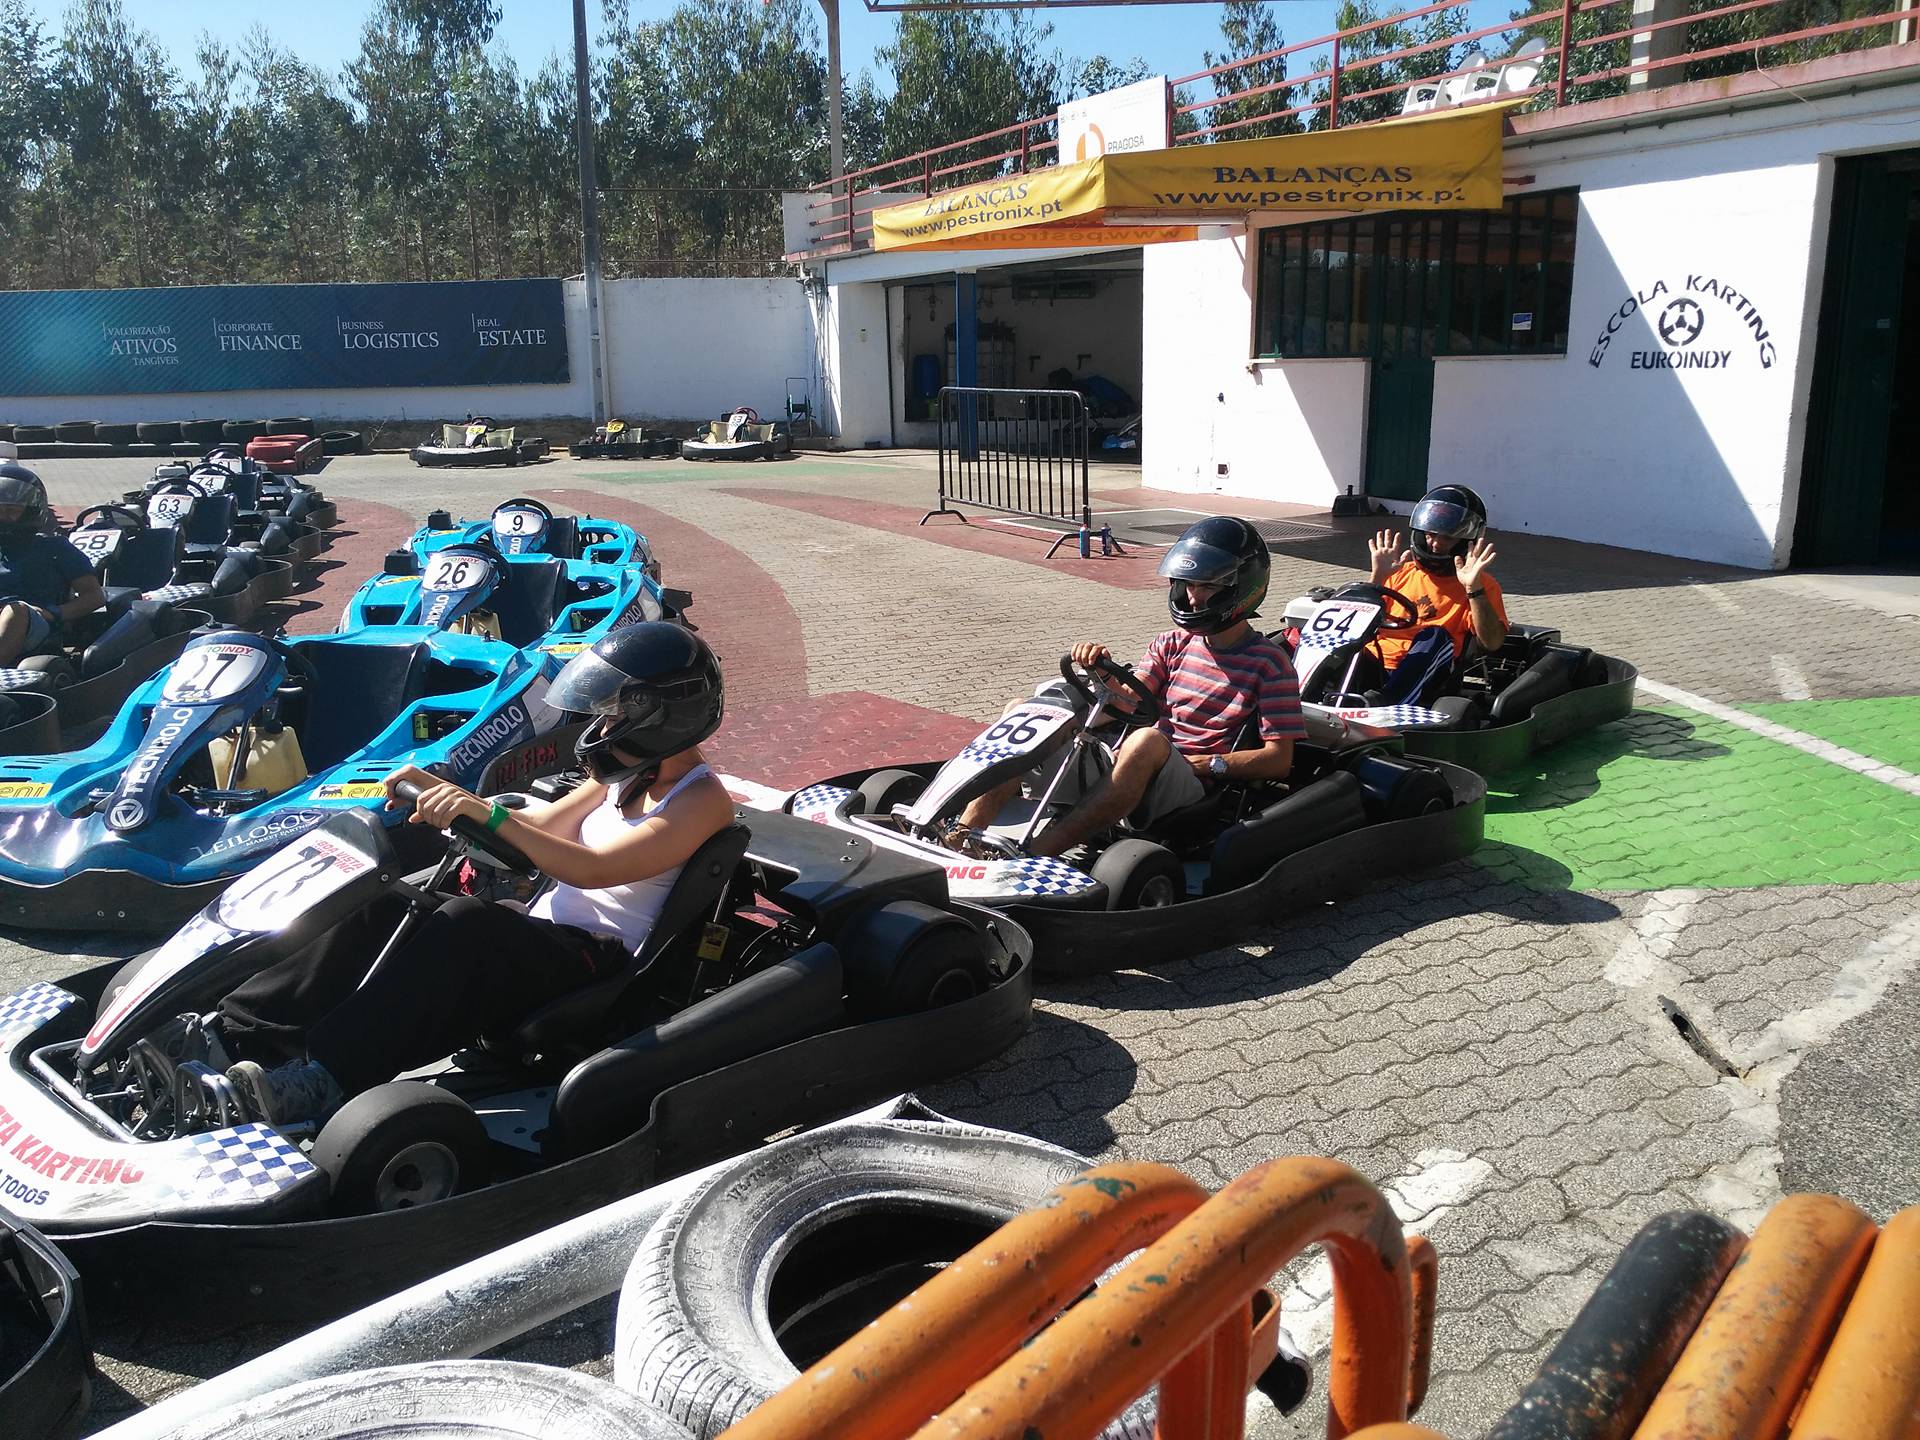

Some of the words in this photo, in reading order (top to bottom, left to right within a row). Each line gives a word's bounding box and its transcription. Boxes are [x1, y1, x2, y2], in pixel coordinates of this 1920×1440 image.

[1107, 135, 1145, 153] PRAGOSA
[1213, 166, 1413, 187] BALANÇAS
[902, 199, 1064, 238] www.pestronix.pt
[107, 325, 171, 336] VALORIZAÇÃO
[218, 323, 273, 332] CORPORATE
[341, 321, 384, 330] BUSINESS
[477, 319, 500, 327] REAL
[1588, 280, 1669, 369] ESCOLA
[1686, 274, 1777, 369] KARTING
[110, 337, 177, 355] ATIVOS
[220, 334, 302, 351] FINANCE
[343, 332, 440, 349] LOGISTICS
[479, 329, 547, 346] ESTATE
[1631, 350, 1732, 369] EUROINDY
[197, 477, 214, 488] 74
[158, 498, 181, 513] 63
[512, 515, 524, 531] 9
[73, 535, 109, 550] 68
[434, 562, 469, 585] 26
[1312, 608, 1358, 638] 64
[207, 646, 254, 655] OINDY
[175, 654, 238, 693] 27
[986, 712, 1054, 744] 66
[453, 705, 525, 776] TECNIROLO
[122, 708, 193, 797] TECNIROLO
[10, 1134, 145, 1184] KARTING
[0, 1174, 50, 1206] TODOS
